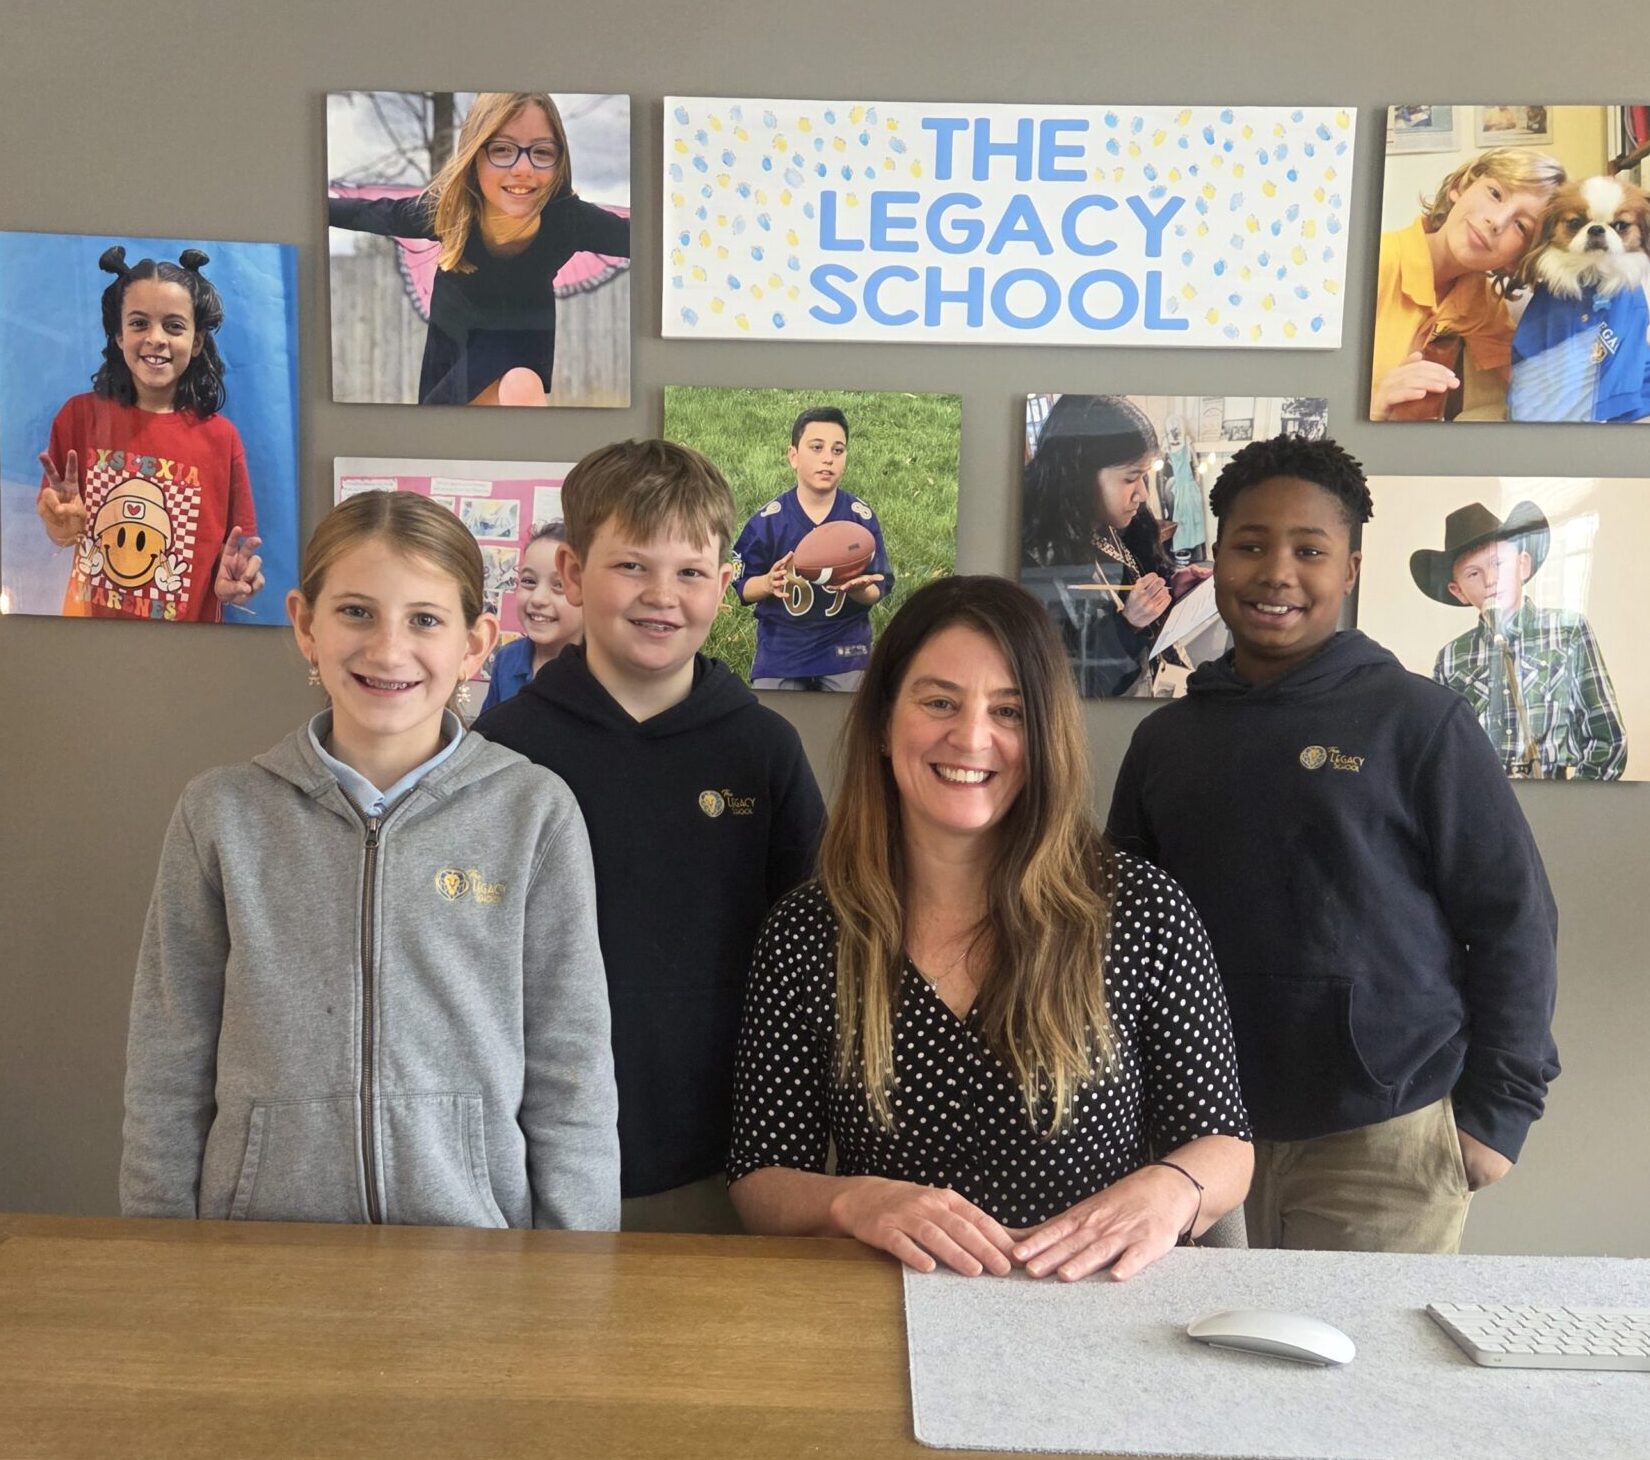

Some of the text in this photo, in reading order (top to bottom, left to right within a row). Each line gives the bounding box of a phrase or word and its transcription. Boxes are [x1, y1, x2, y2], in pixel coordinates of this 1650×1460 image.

[921, 117, 1090, 181] THE
[818, 190, 1186, 257] LEGACY
[808, 264, 1189, 331] SCHOOL
[86, 448, 201, 487] DYSLEXIA
[76, 586, 188, 620] WARENESS
